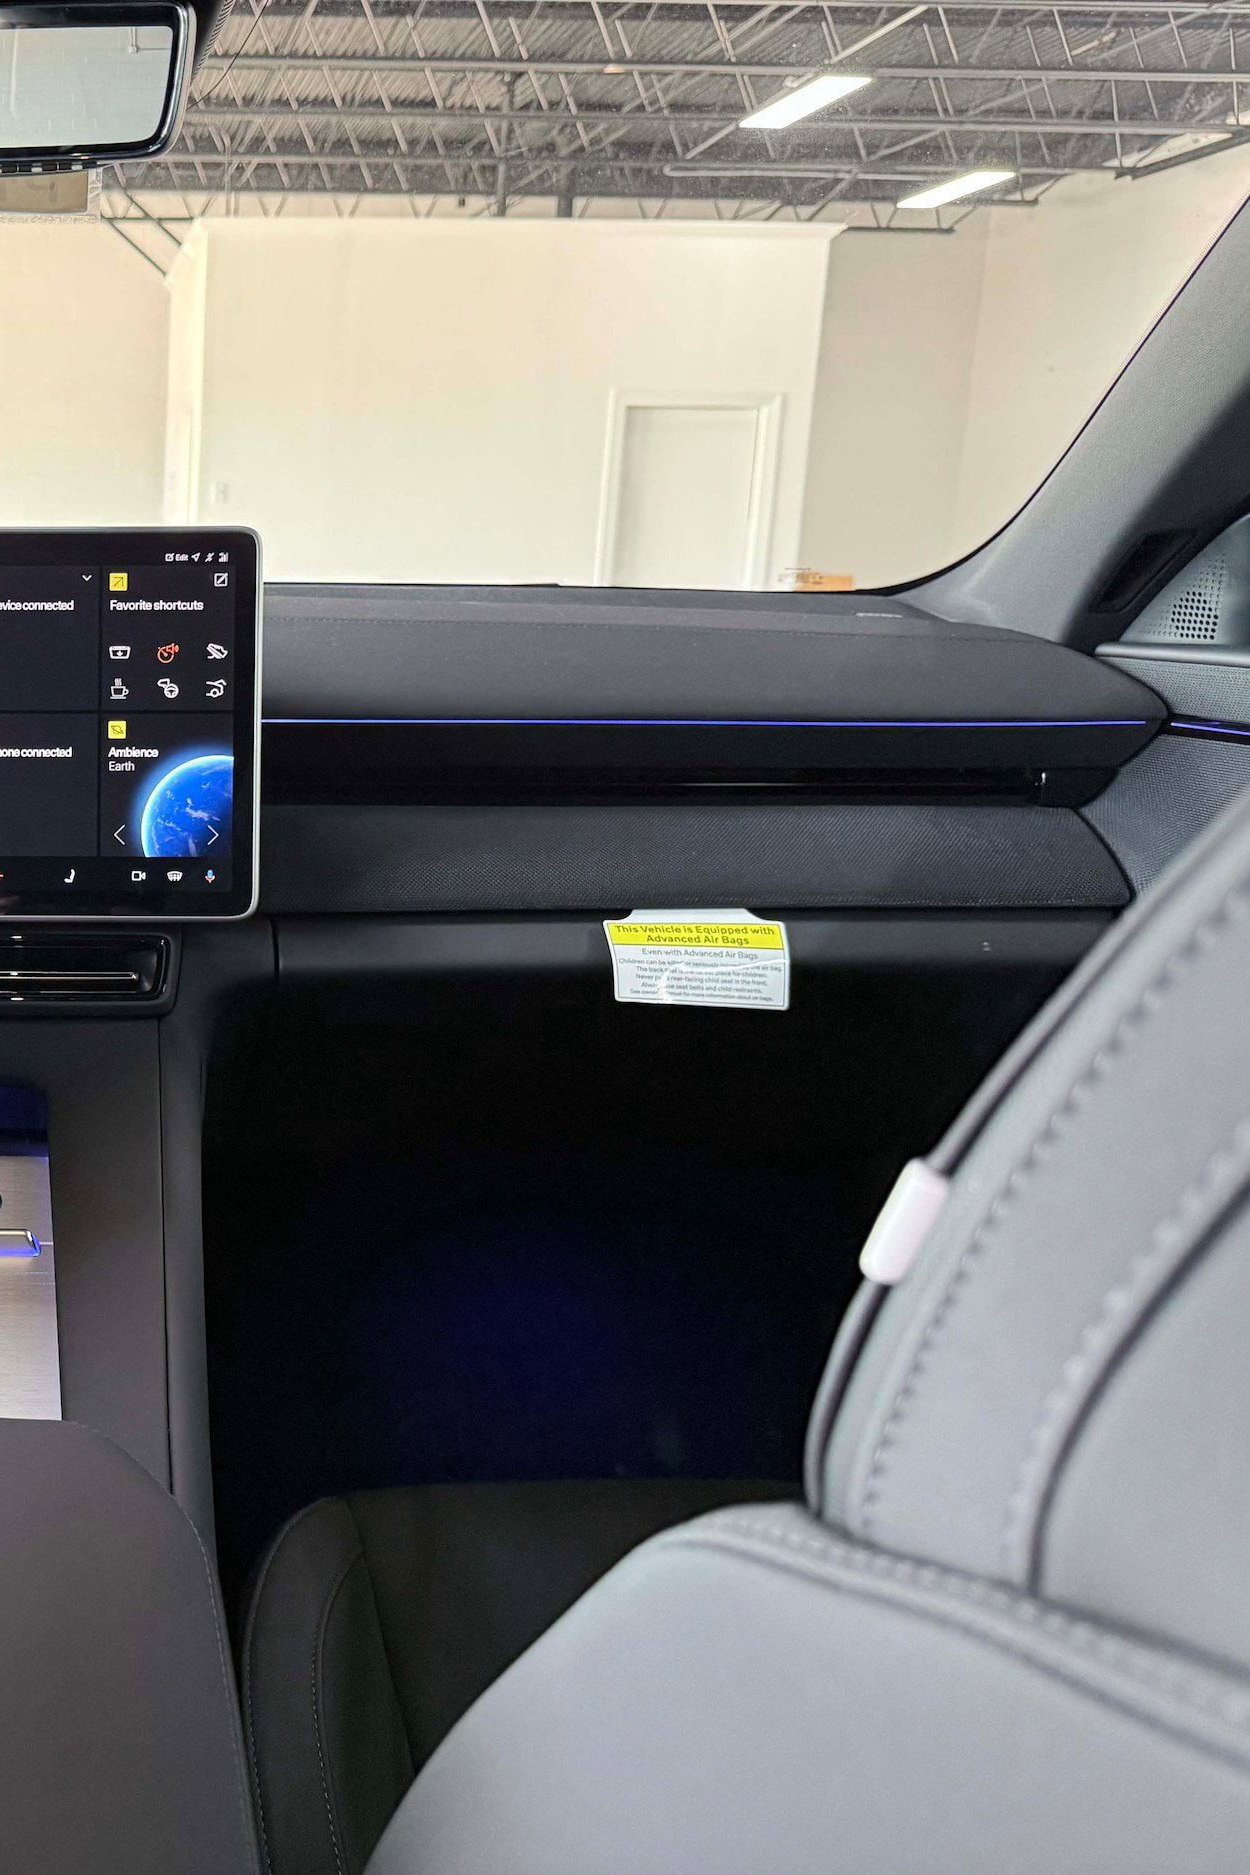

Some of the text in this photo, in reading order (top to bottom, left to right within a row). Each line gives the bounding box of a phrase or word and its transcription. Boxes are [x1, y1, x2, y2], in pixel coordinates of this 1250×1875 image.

[175, 553, 189, 561] Edit
[22, 599, 75, 611] connected
[110, 599, 204, 611] Favorite shortcuts
[21, 746, 73, 758] connected
[108, 746, 159, 758] Ambience
[109, 761, 136, 772] Earth
[614, 924, 775, 936] This Vehicle is Equipped with
[646, 934, 750, 946] Advanced Air Bags
[641, 947, 662, 956] Even
[663, 948, 682, 956] with
[683, 948, 723, 957] Advanced
[738, 951, 759, 960] Bags
